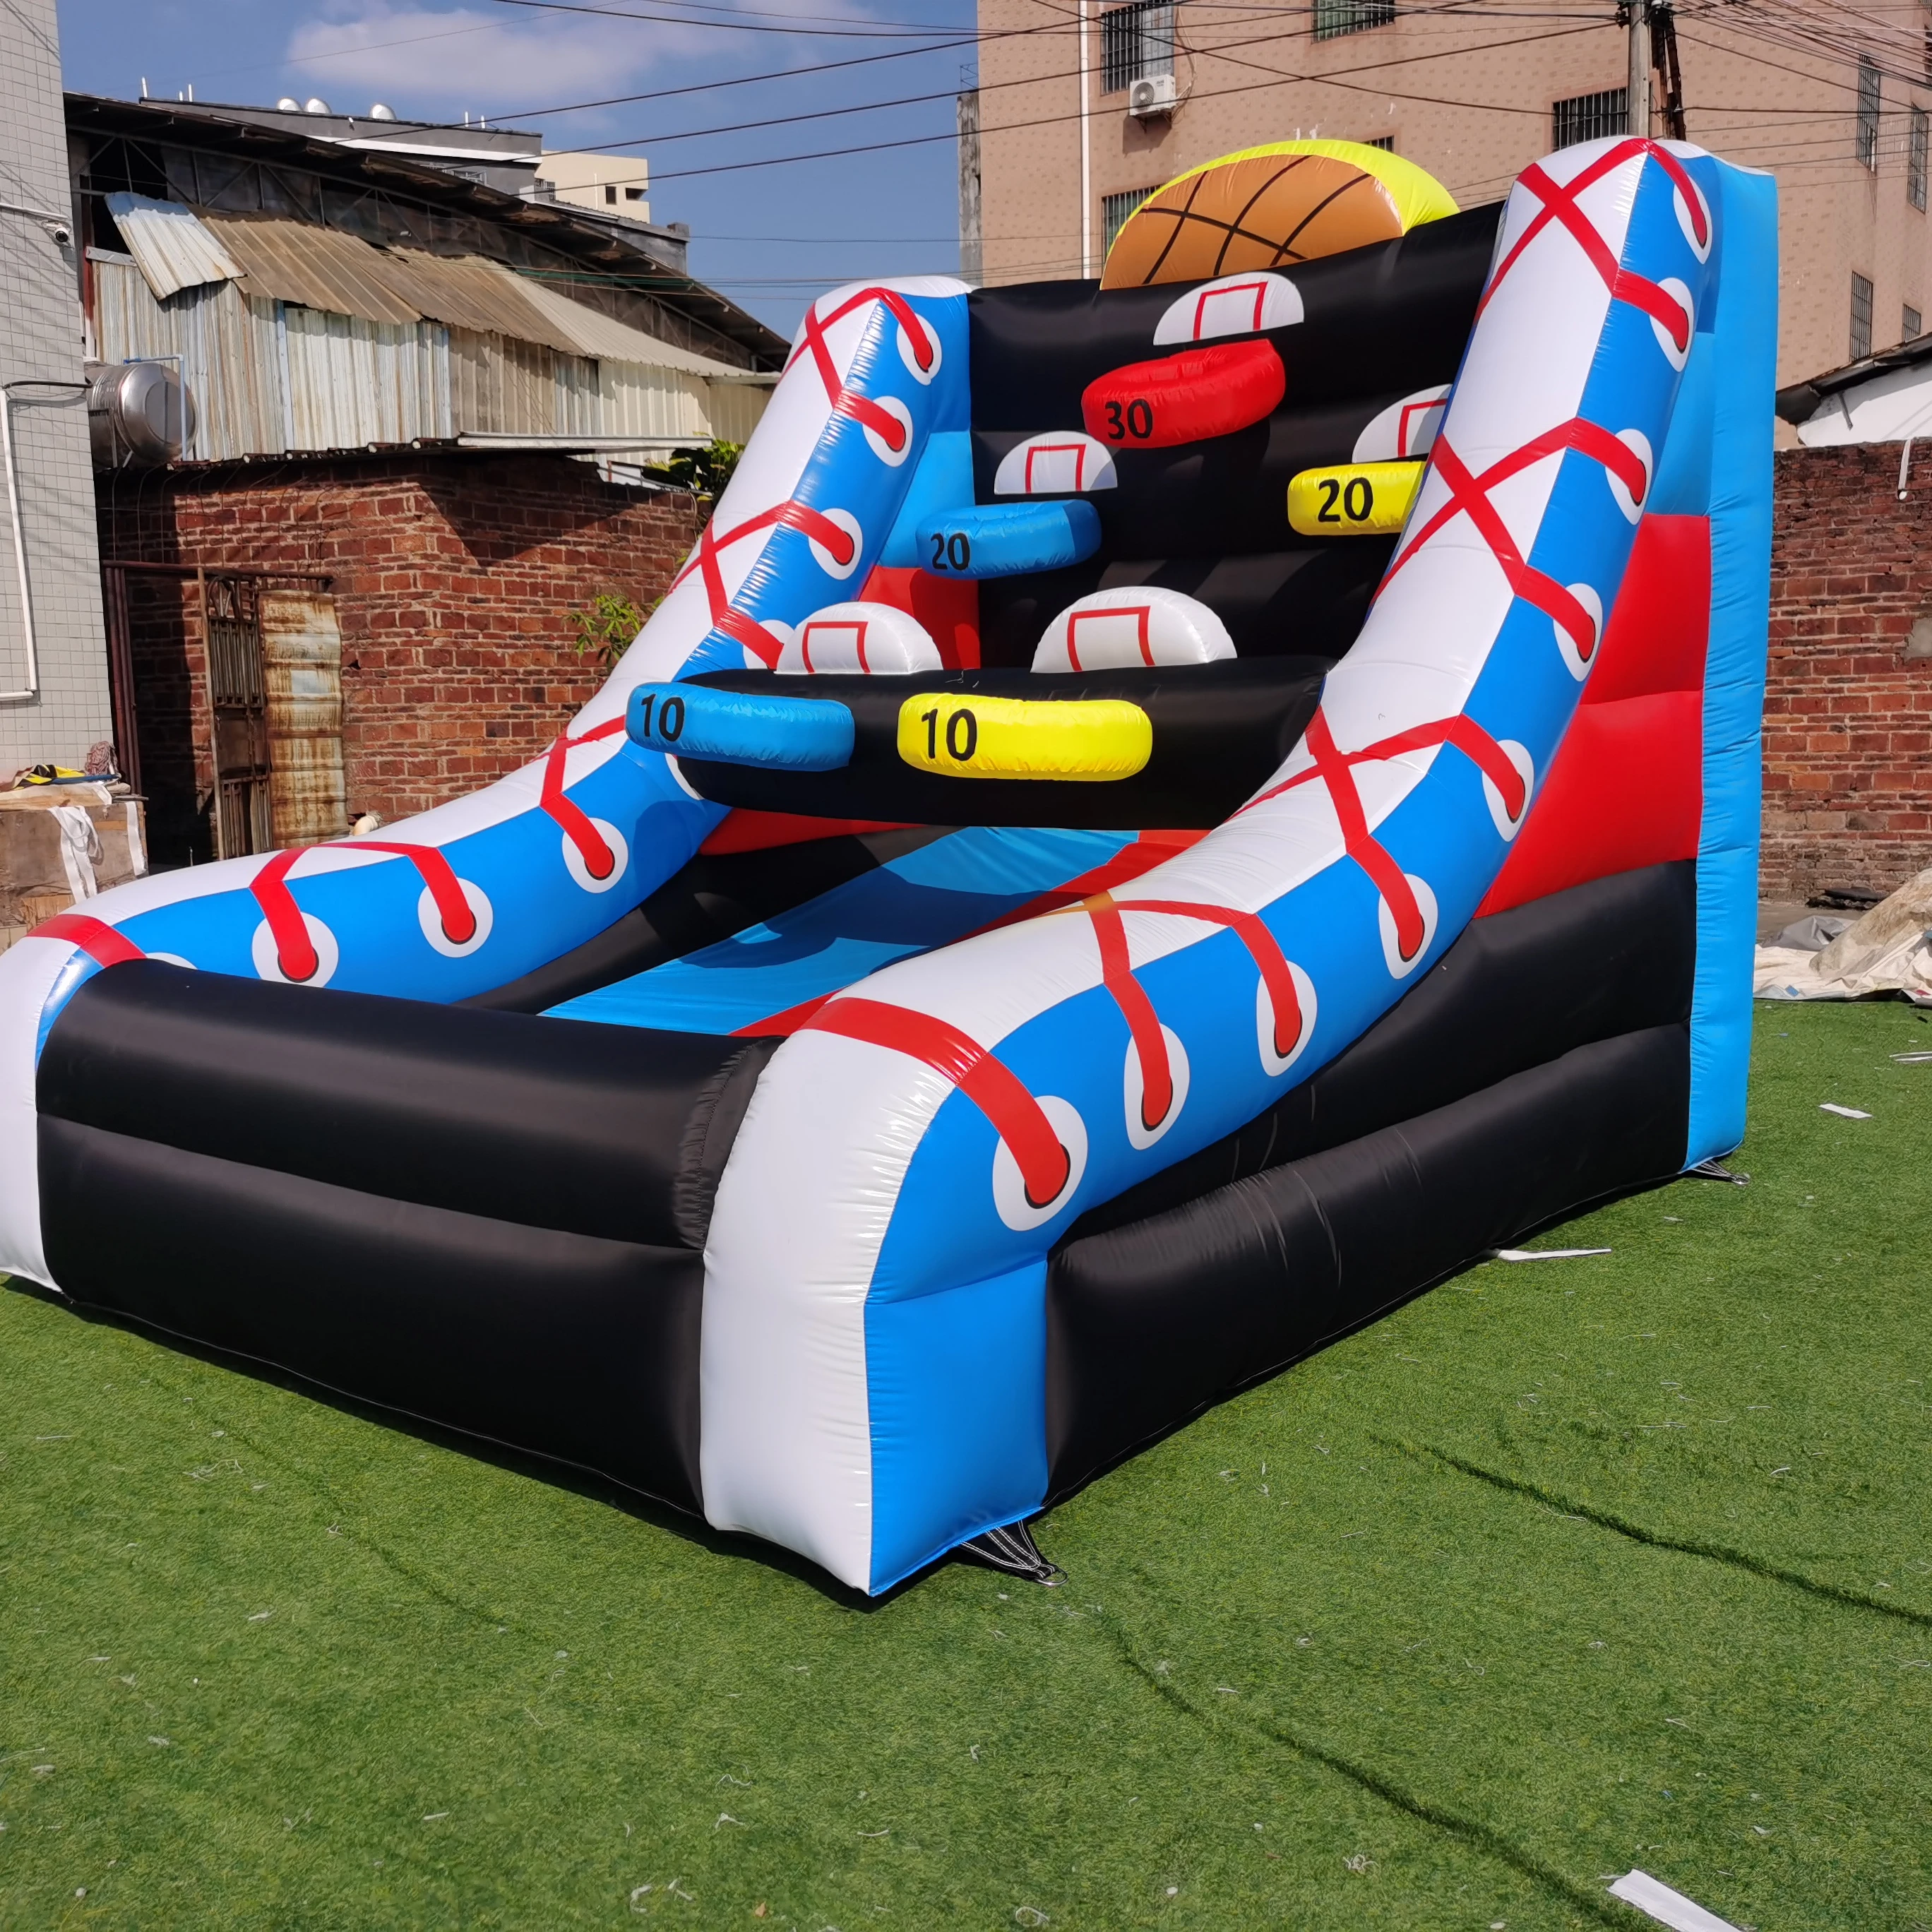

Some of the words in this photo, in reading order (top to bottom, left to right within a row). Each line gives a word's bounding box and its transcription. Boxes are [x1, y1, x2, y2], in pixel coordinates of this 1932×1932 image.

[1105, 398, 1152, 439] 30
[1318, 477, 1373, 522] 20
[931, 532, 970, 571] 20
[641, 693, 685, 742] 10
[922, 708, 977, 761] 10
